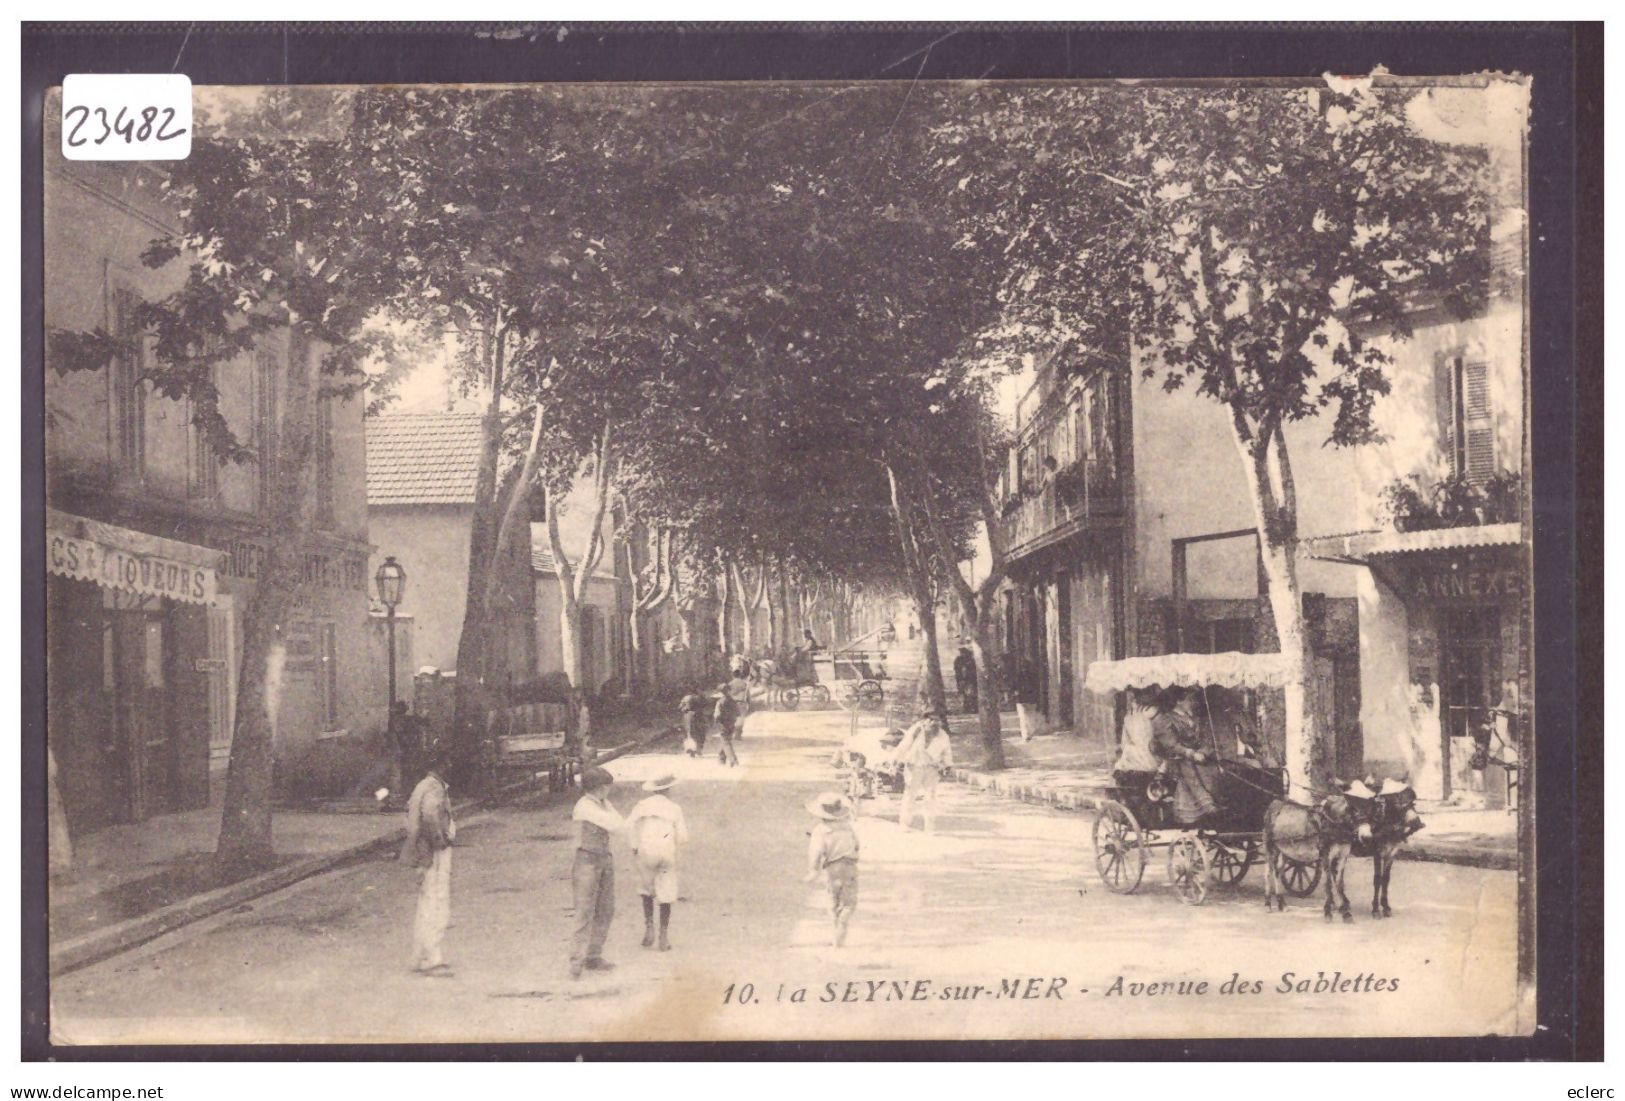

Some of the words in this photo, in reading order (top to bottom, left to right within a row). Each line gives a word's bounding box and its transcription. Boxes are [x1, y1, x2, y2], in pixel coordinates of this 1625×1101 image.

[65, 105, 187, 147] 23482
[102, 551, 206, 599] LIQUEURS
[1415, 571, 1521, 598] ANNEXE
